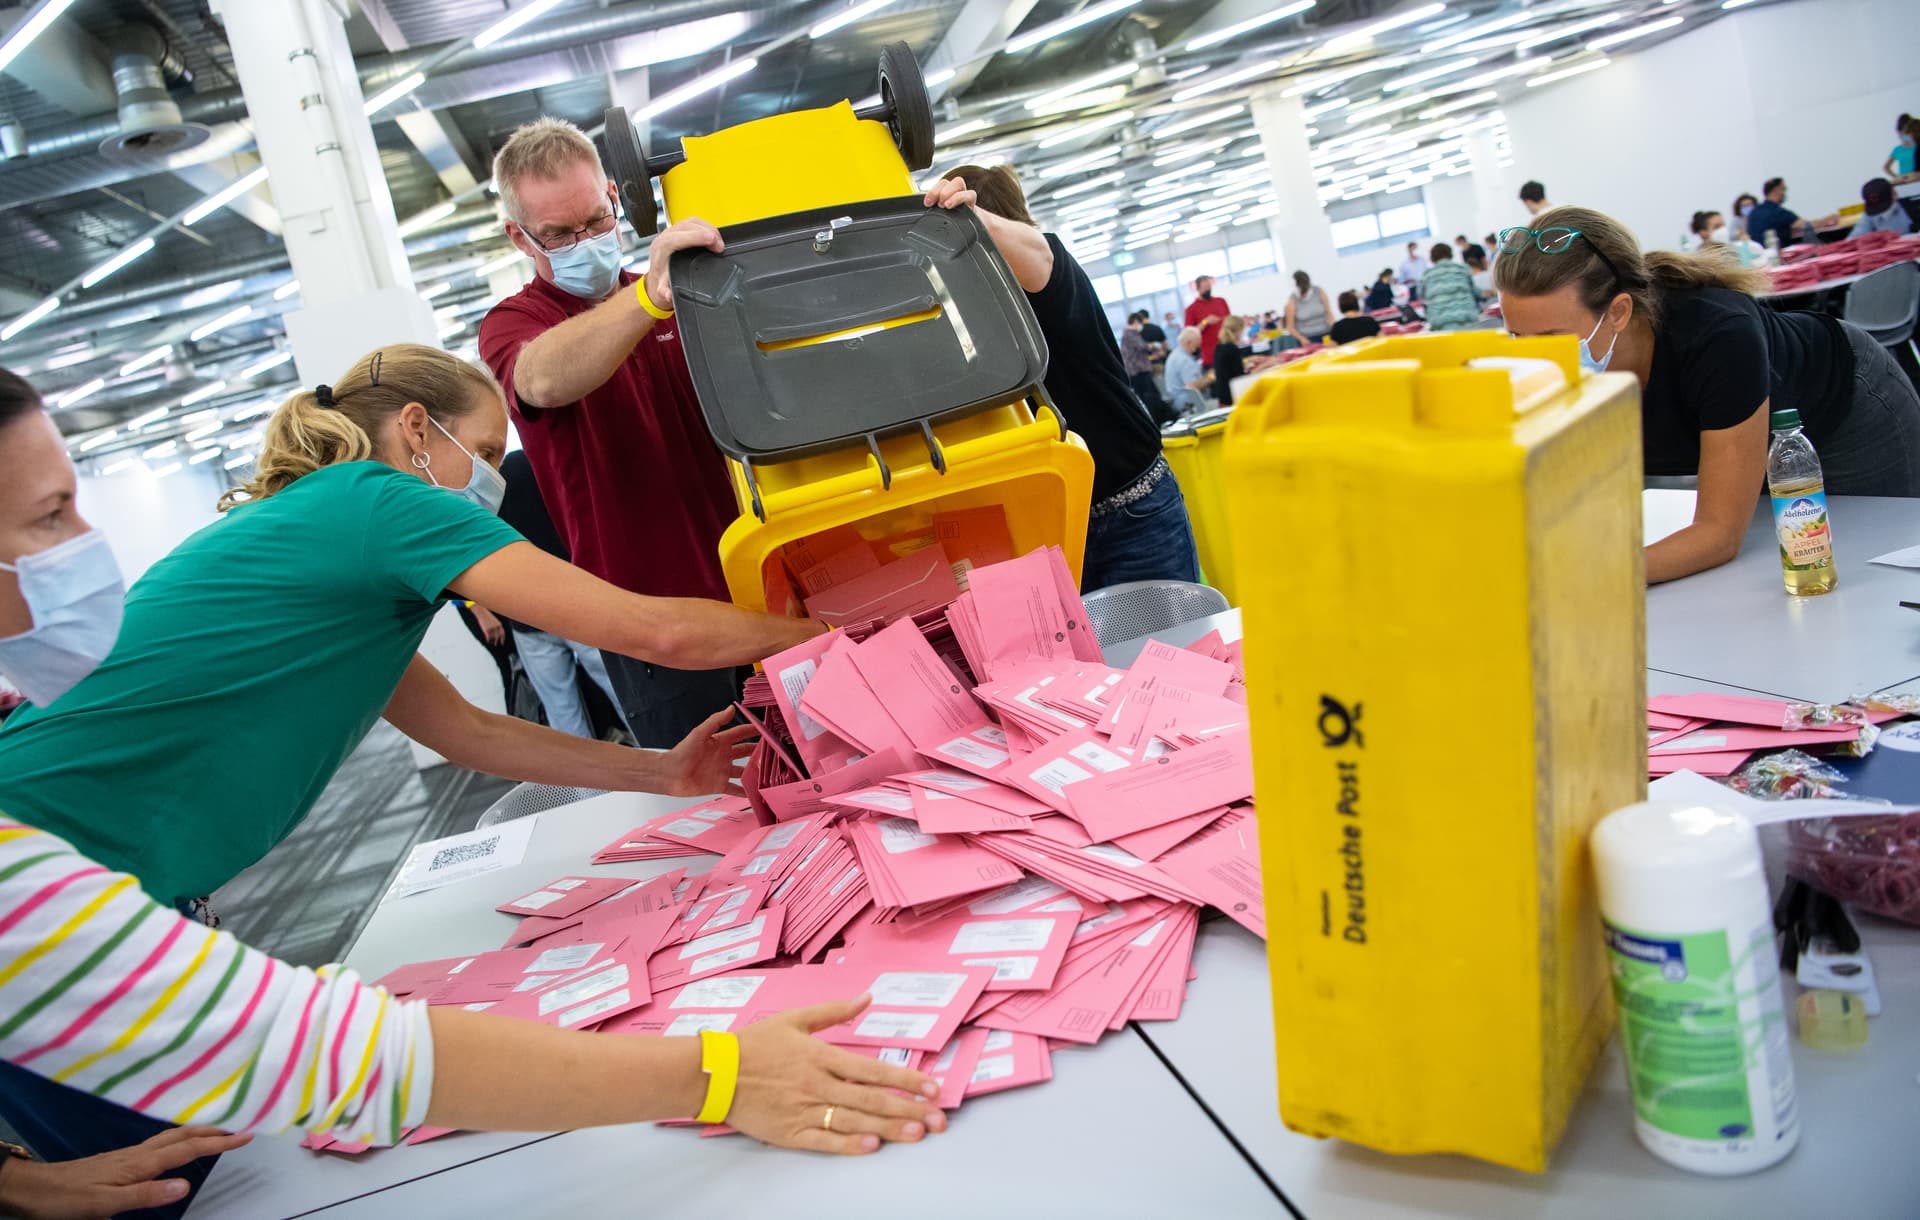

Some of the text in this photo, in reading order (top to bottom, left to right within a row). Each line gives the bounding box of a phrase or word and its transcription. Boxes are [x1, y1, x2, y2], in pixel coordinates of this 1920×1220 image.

[1794, 539, 1821, 549] APFEL
[1794, 545, 1825, 557] KRÄUTER
[1336, 761, 1367, 945] Deutsche Post
